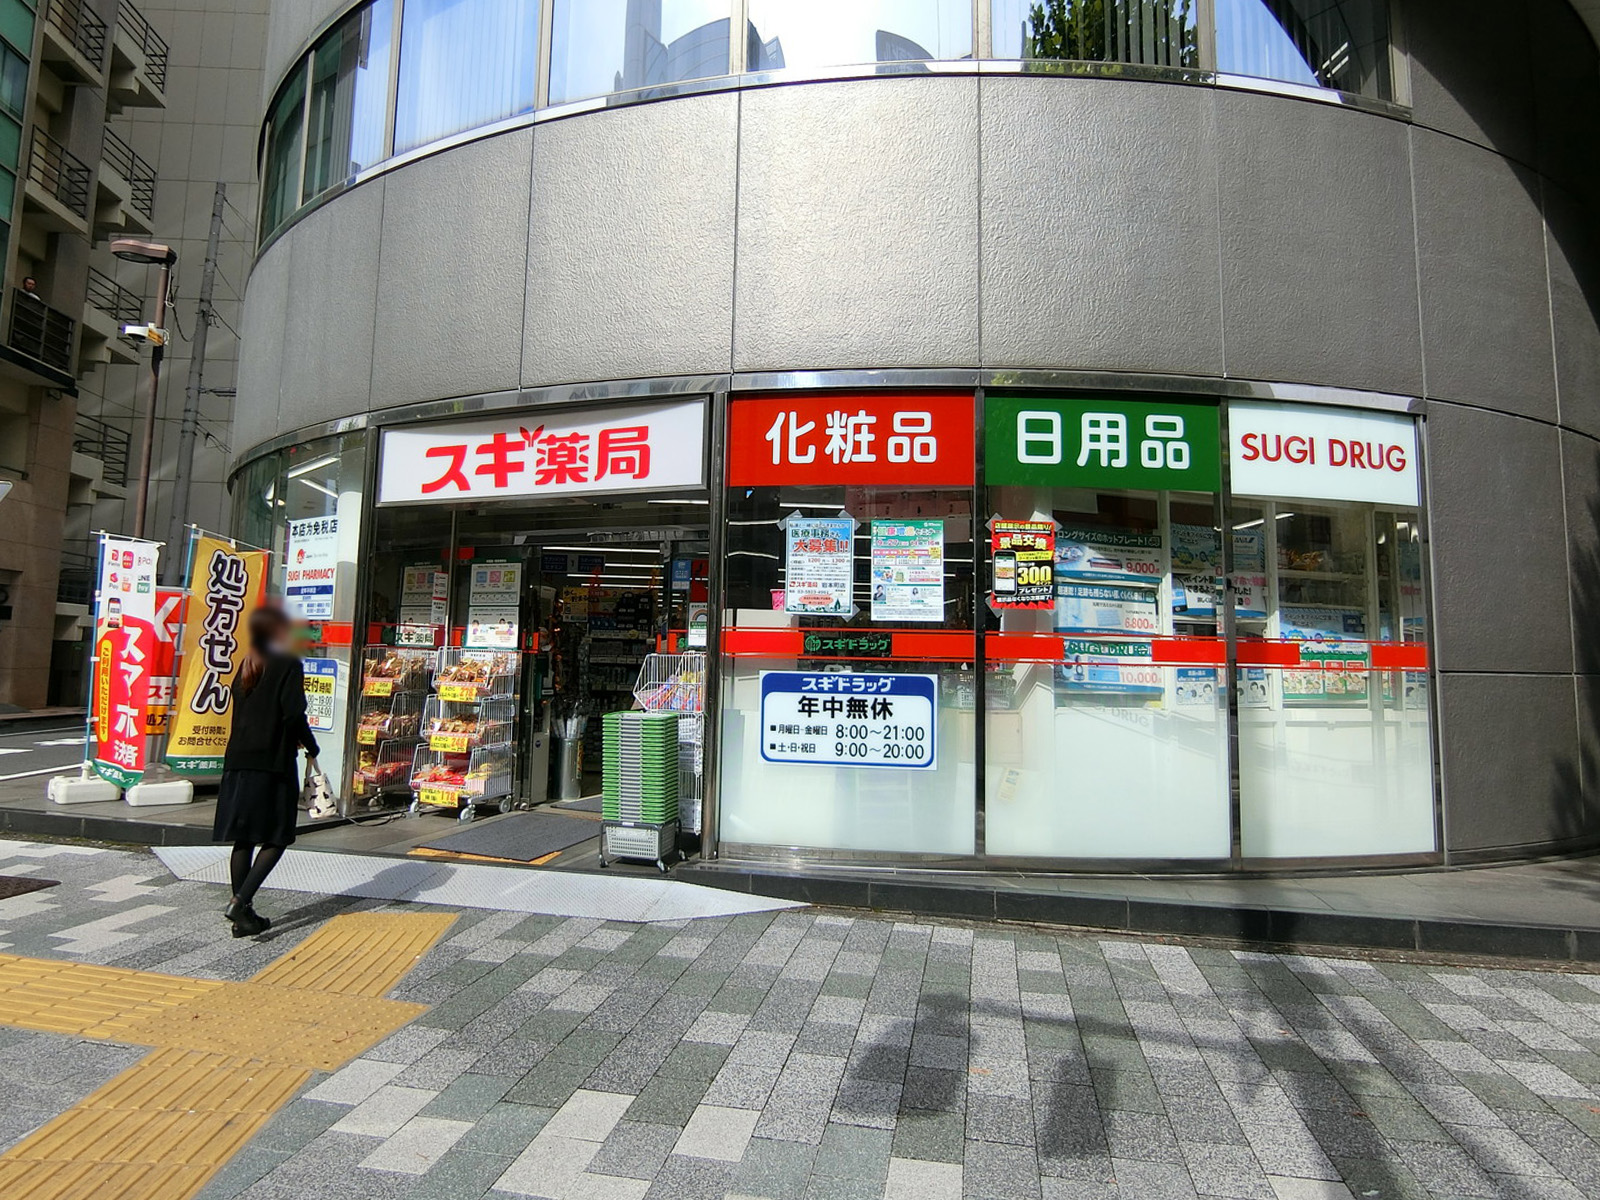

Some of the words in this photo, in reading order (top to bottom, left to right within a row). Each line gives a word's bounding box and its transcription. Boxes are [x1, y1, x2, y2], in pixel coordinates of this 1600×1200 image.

[765, 410, 937, 465] 化粧品
[1017, 411, 1190, 469] 日用品
[421, 424, 651, 494] スギ薬局
[1241, 433, 1315, 465] SUGI
[1328, 438, 1407, 472] DRUG
[291, 519, 338, 537] 本店为免税店
[794, 539, 849, 552] 大募集!!
[287, 570, 301, 581] SUGI
[302, 568, 335, 580] PHARMACY
[1017, 566, 1052, 585] 300
[190, 549, 249, 715] 処方せん
[821, 637, 891, 651] スギドラッグ
[801, 676, 896, 692] スギドラッグ
[797, 695, 894, 720] 年中無休
[835, 724, 925, 741] 8:00~21:00
[834, 742, 925, 759] 9:00~20:00
